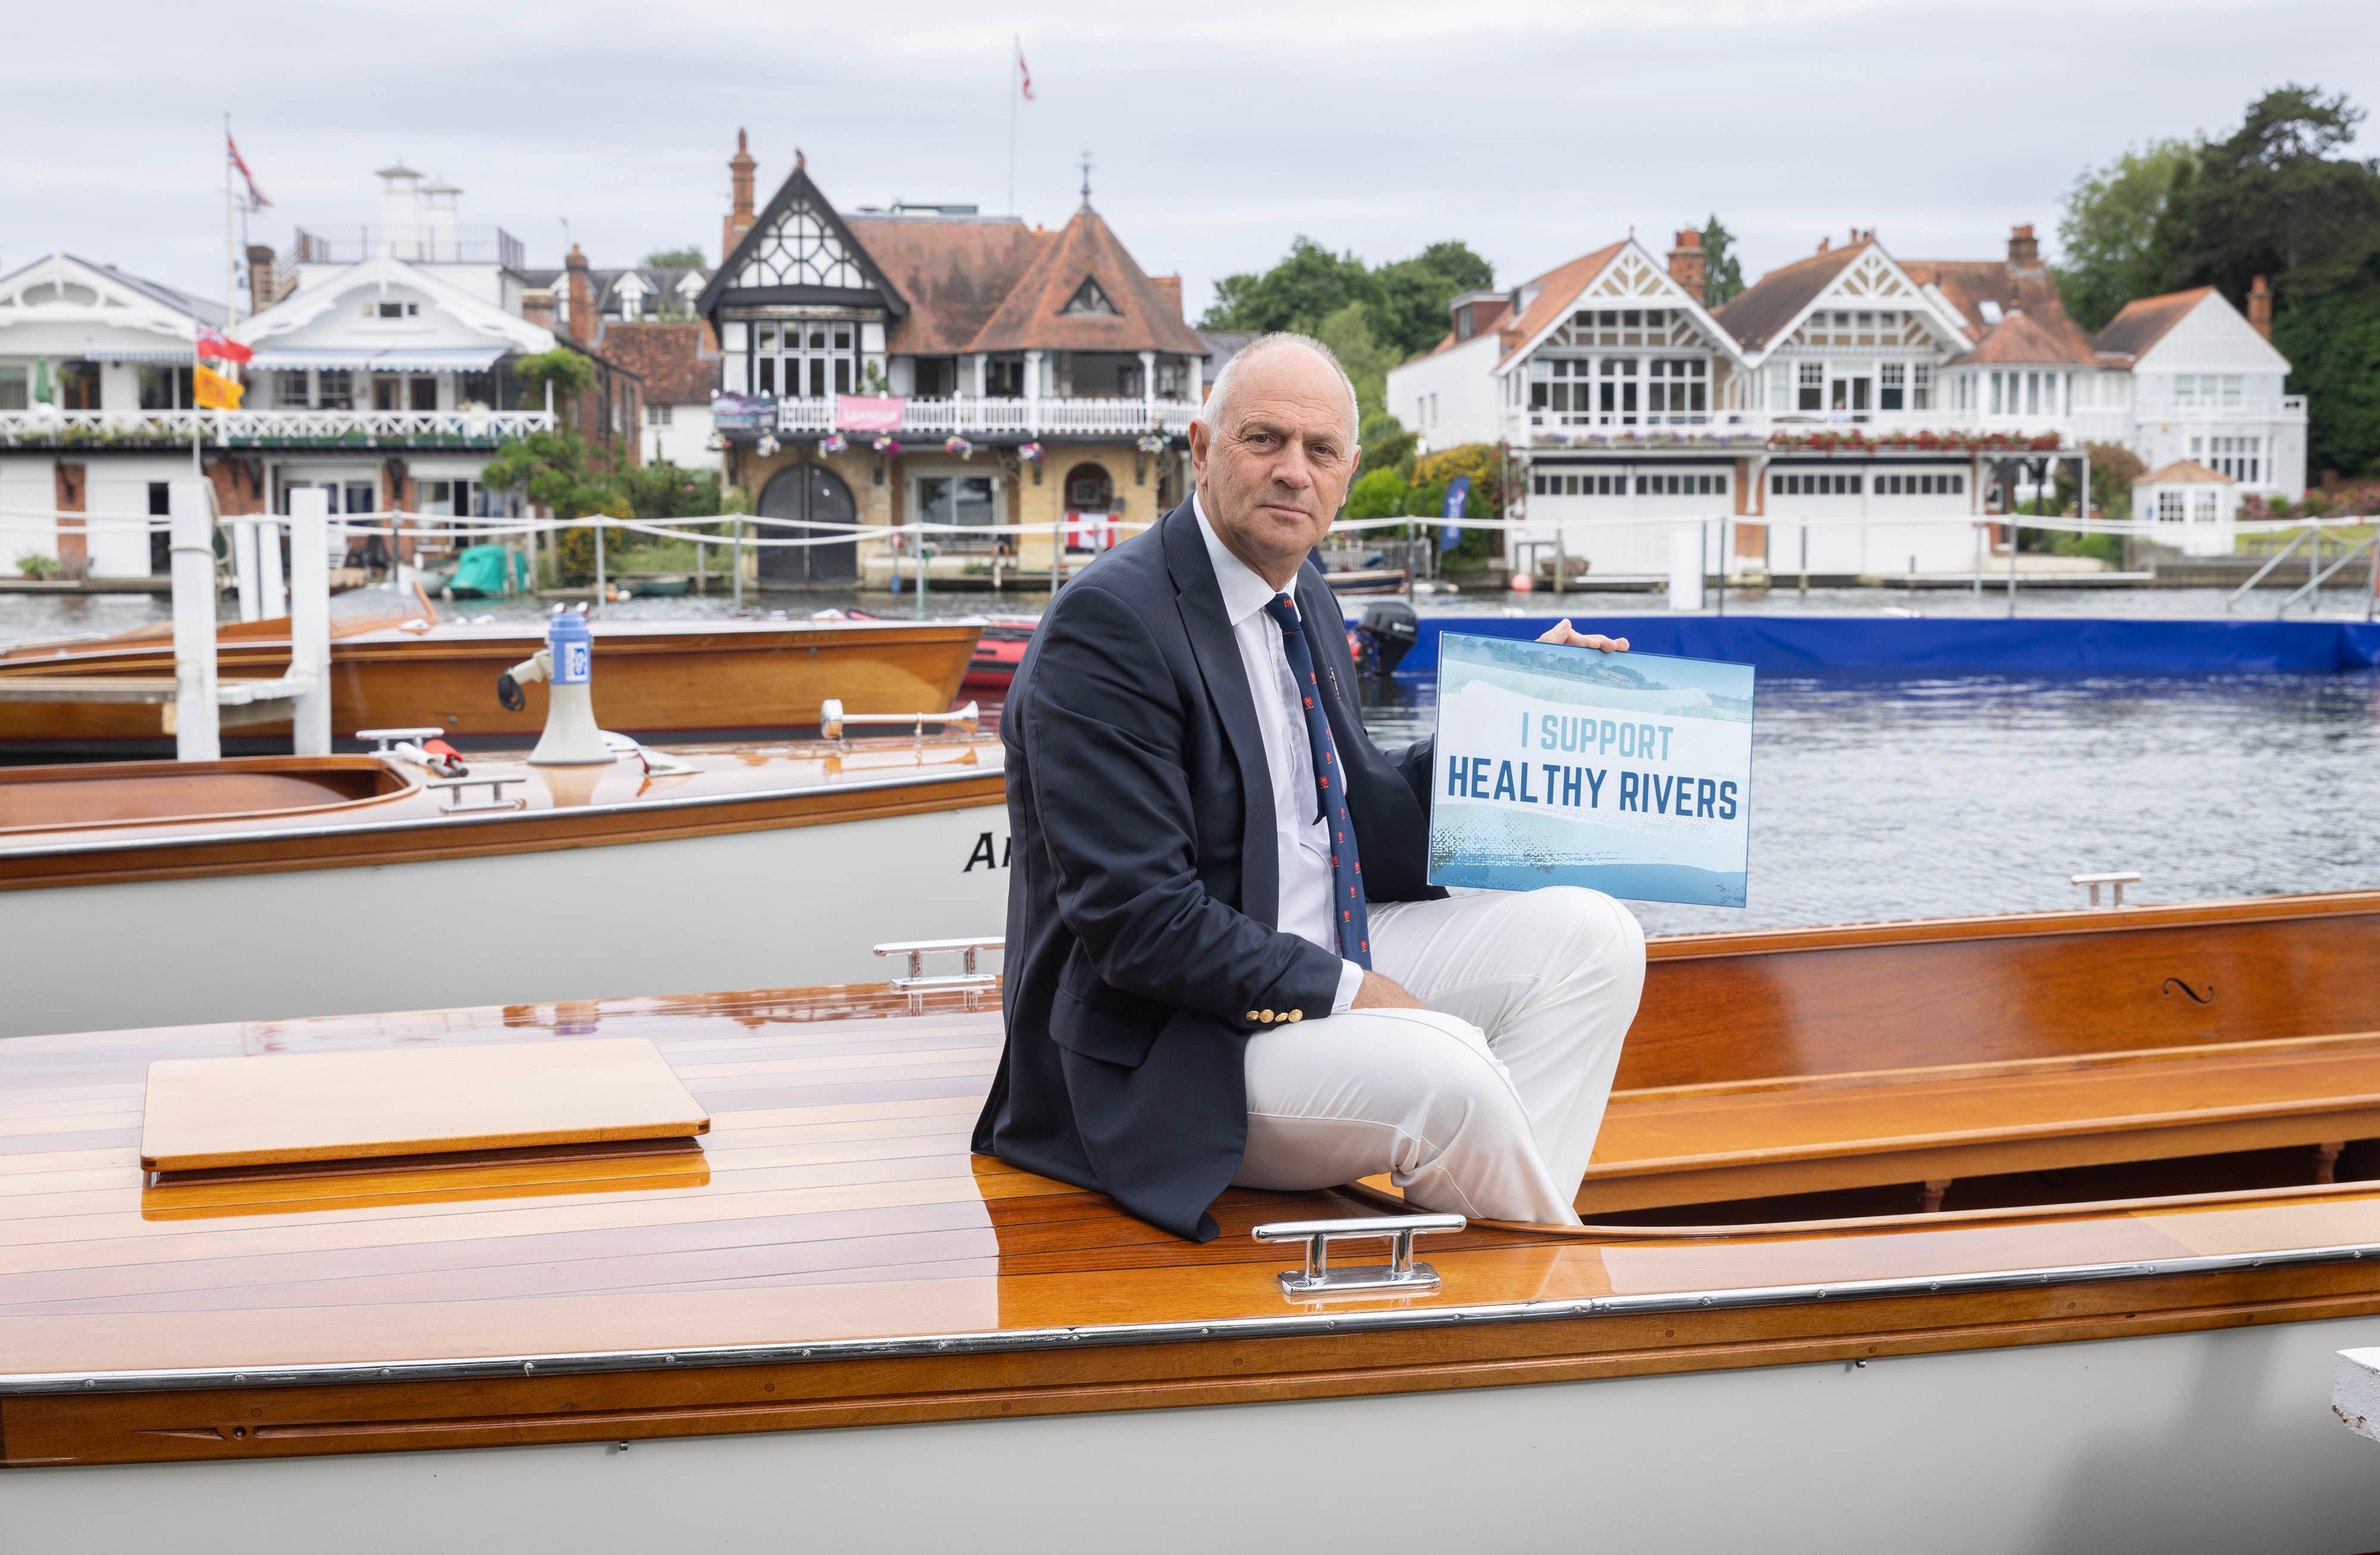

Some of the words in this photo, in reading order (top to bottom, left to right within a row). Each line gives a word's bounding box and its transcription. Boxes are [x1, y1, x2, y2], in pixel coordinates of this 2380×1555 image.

[1521, 712, 1529, 748] I
[1540, 714, 1674, 761] SUPPORT
[1448, 755, 1608, 809] HEALTHY
[1620, 771, 1737, 821] RIVERS
